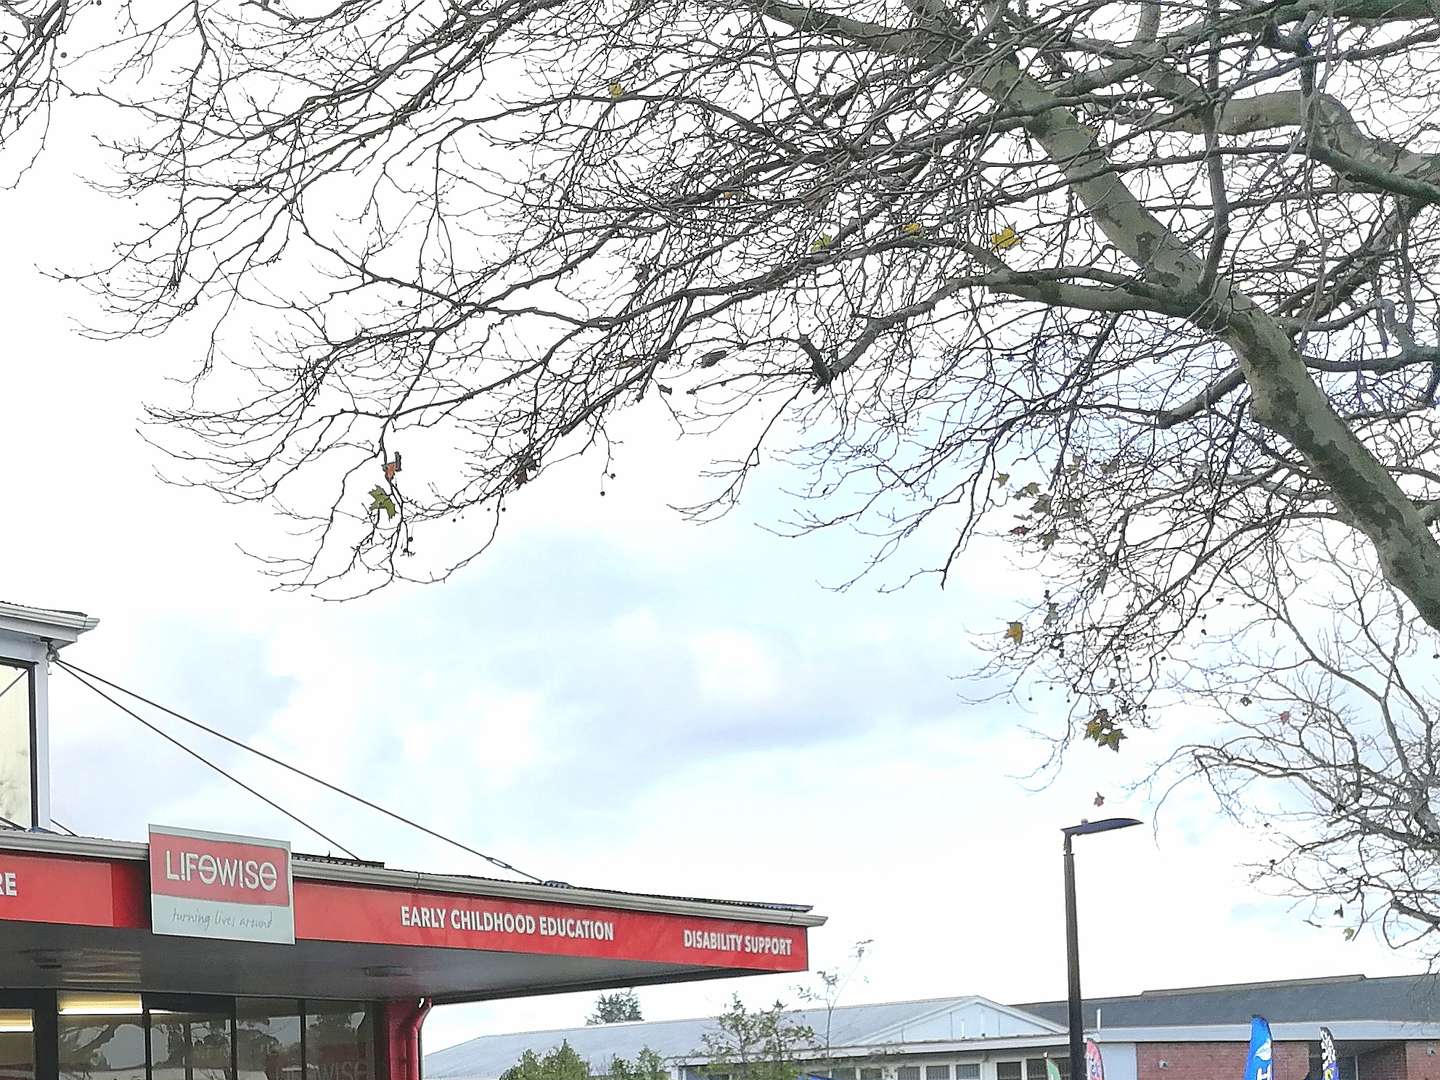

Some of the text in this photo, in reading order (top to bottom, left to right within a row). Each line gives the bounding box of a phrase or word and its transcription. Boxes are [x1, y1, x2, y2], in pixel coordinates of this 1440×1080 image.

[171, 908, 273, 929] turning lives around
[400, 905, 614, 941] EARLY CHILDHOOD EDUCATION
[683, 929, 792, 956] DISABILITY SUPPORT
